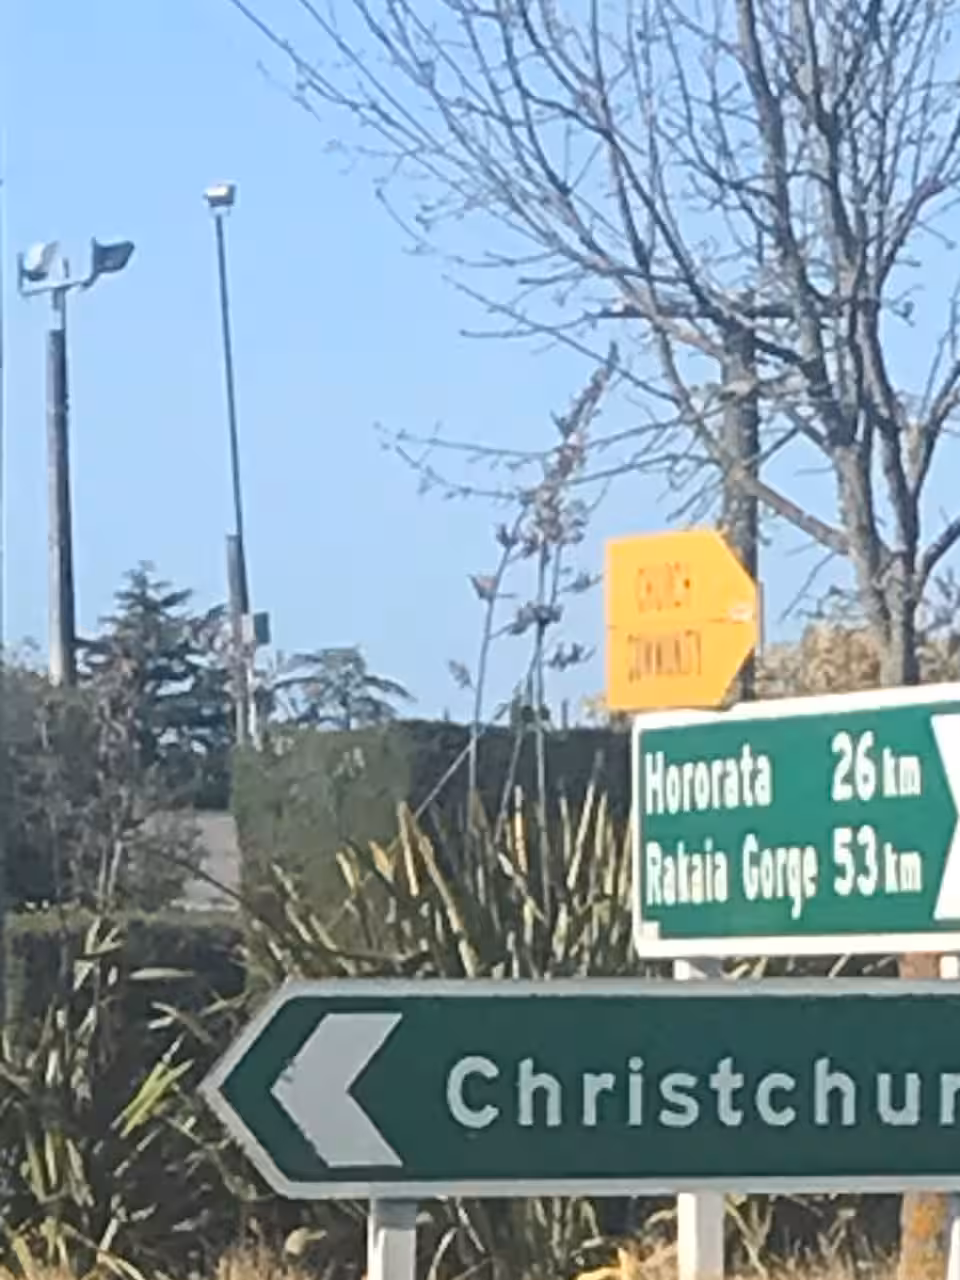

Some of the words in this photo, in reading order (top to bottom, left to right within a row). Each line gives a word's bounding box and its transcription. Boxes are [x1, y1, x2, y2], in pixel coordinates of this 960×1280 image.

[645, 744, 772, 815] Hororata
[645, 838, 729, 906] Rakaia
[742, 833, 819, 919] Gorge
